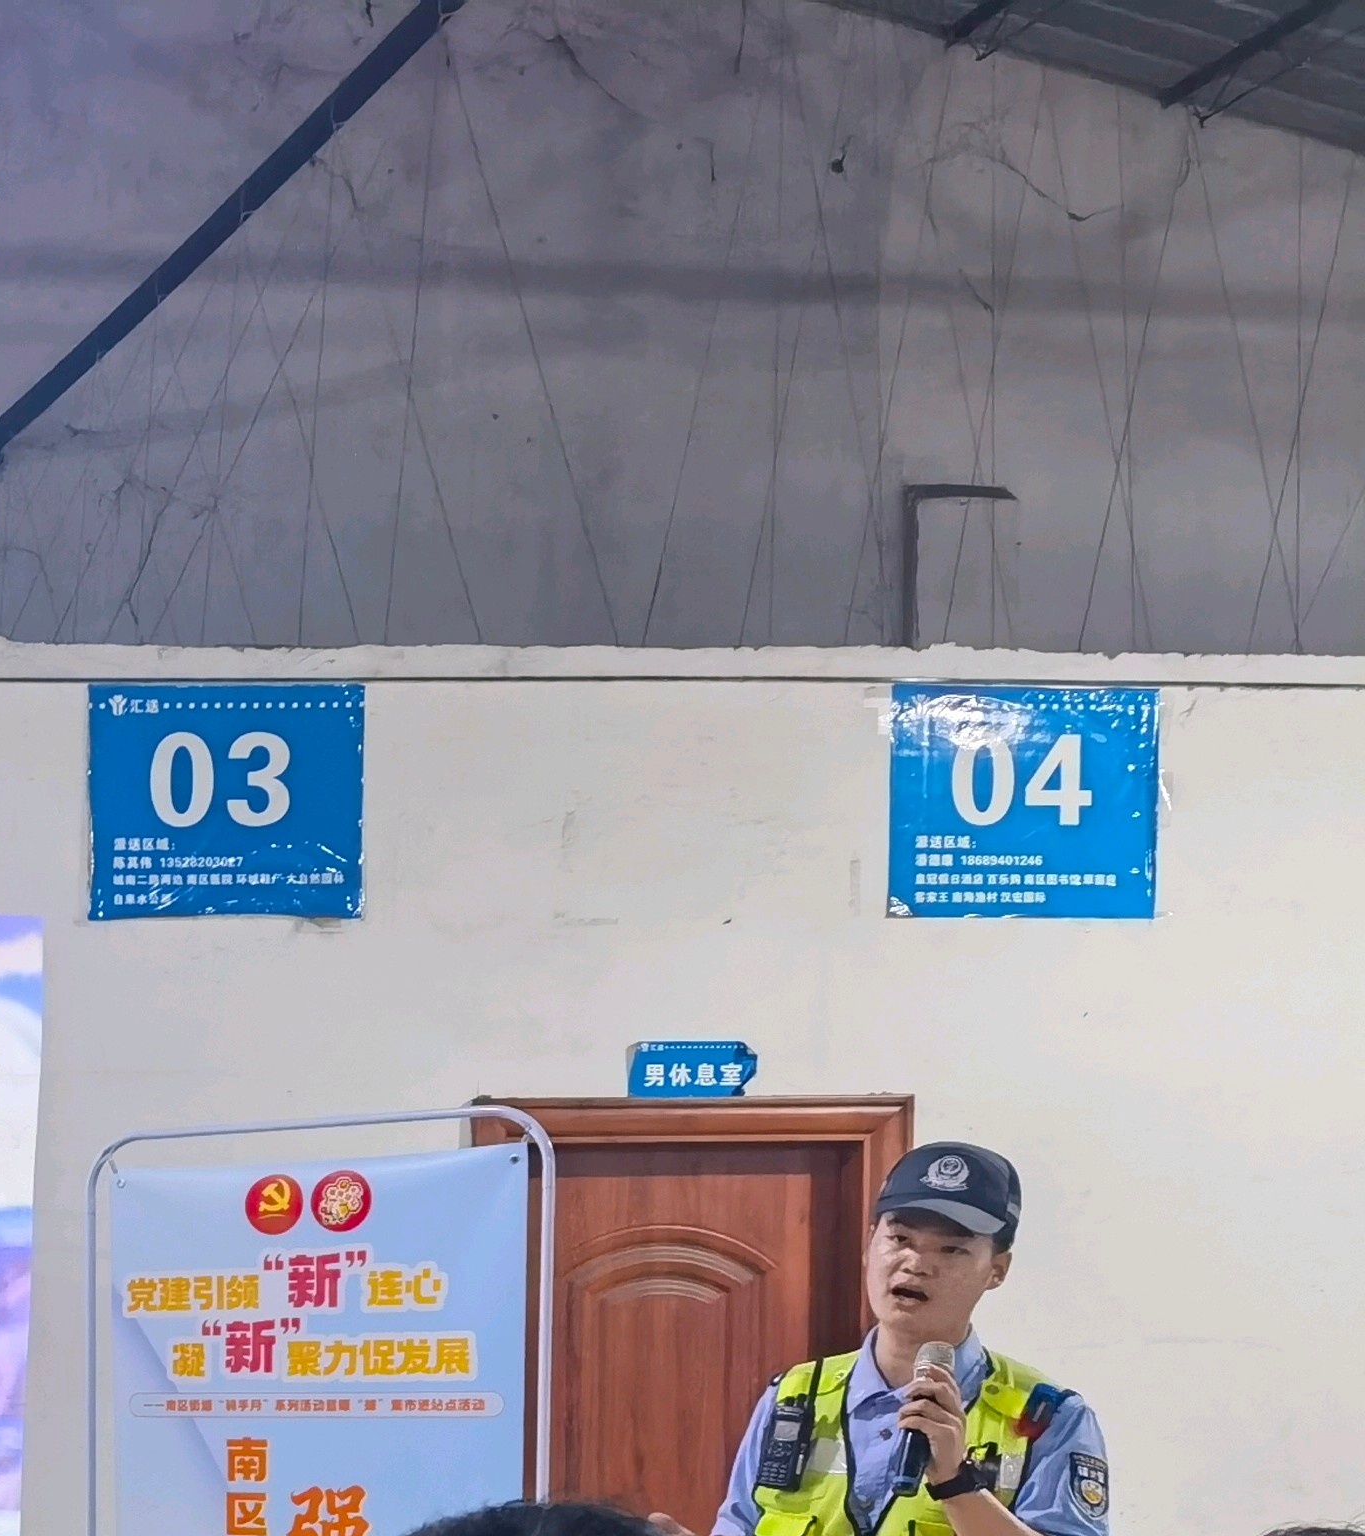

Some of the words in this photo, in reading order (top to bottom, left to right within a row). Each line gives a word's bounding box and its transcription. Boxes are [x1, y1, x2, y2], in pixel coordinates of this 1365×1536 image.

[150, 731, 291, 828] 03
[952, 734, 1092, 826] 04
[960, 855, 1044, 866] 18689401246
[643, 1062, 743, 1088] 男休息室
